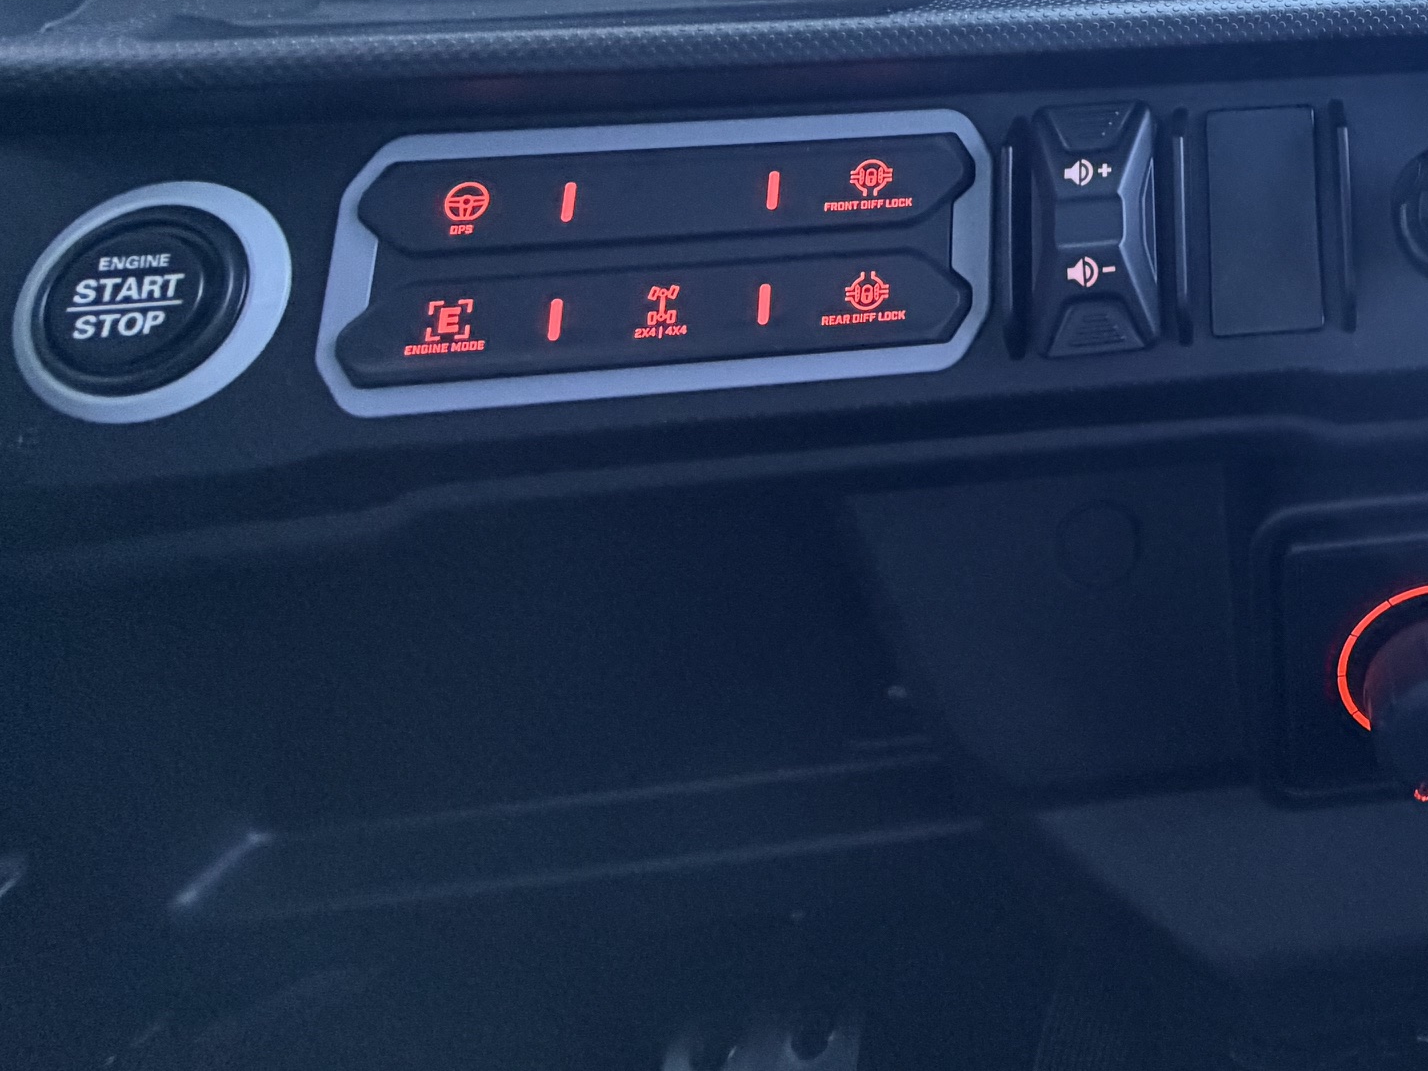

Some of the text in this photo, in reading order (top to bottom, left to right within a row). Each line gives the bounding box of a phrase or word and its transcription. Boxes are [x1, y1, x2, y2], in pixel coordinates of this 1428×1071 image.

[824, 198, 912, 212] FRONT DIFF LOCK
[98, 254, 171, 271] ENGINE
[72, 273, 185, 304] START
[72, 311, 166, 340] STOP
[437, 306, 461, 333] E
[821, 310, 906, 326] REAR DIFF LOCK
[634, 329, 656, 339] 2X4
[665, 326, 687, 336] 4X4
[404, 340, 485, 356] ENGINE MODE
